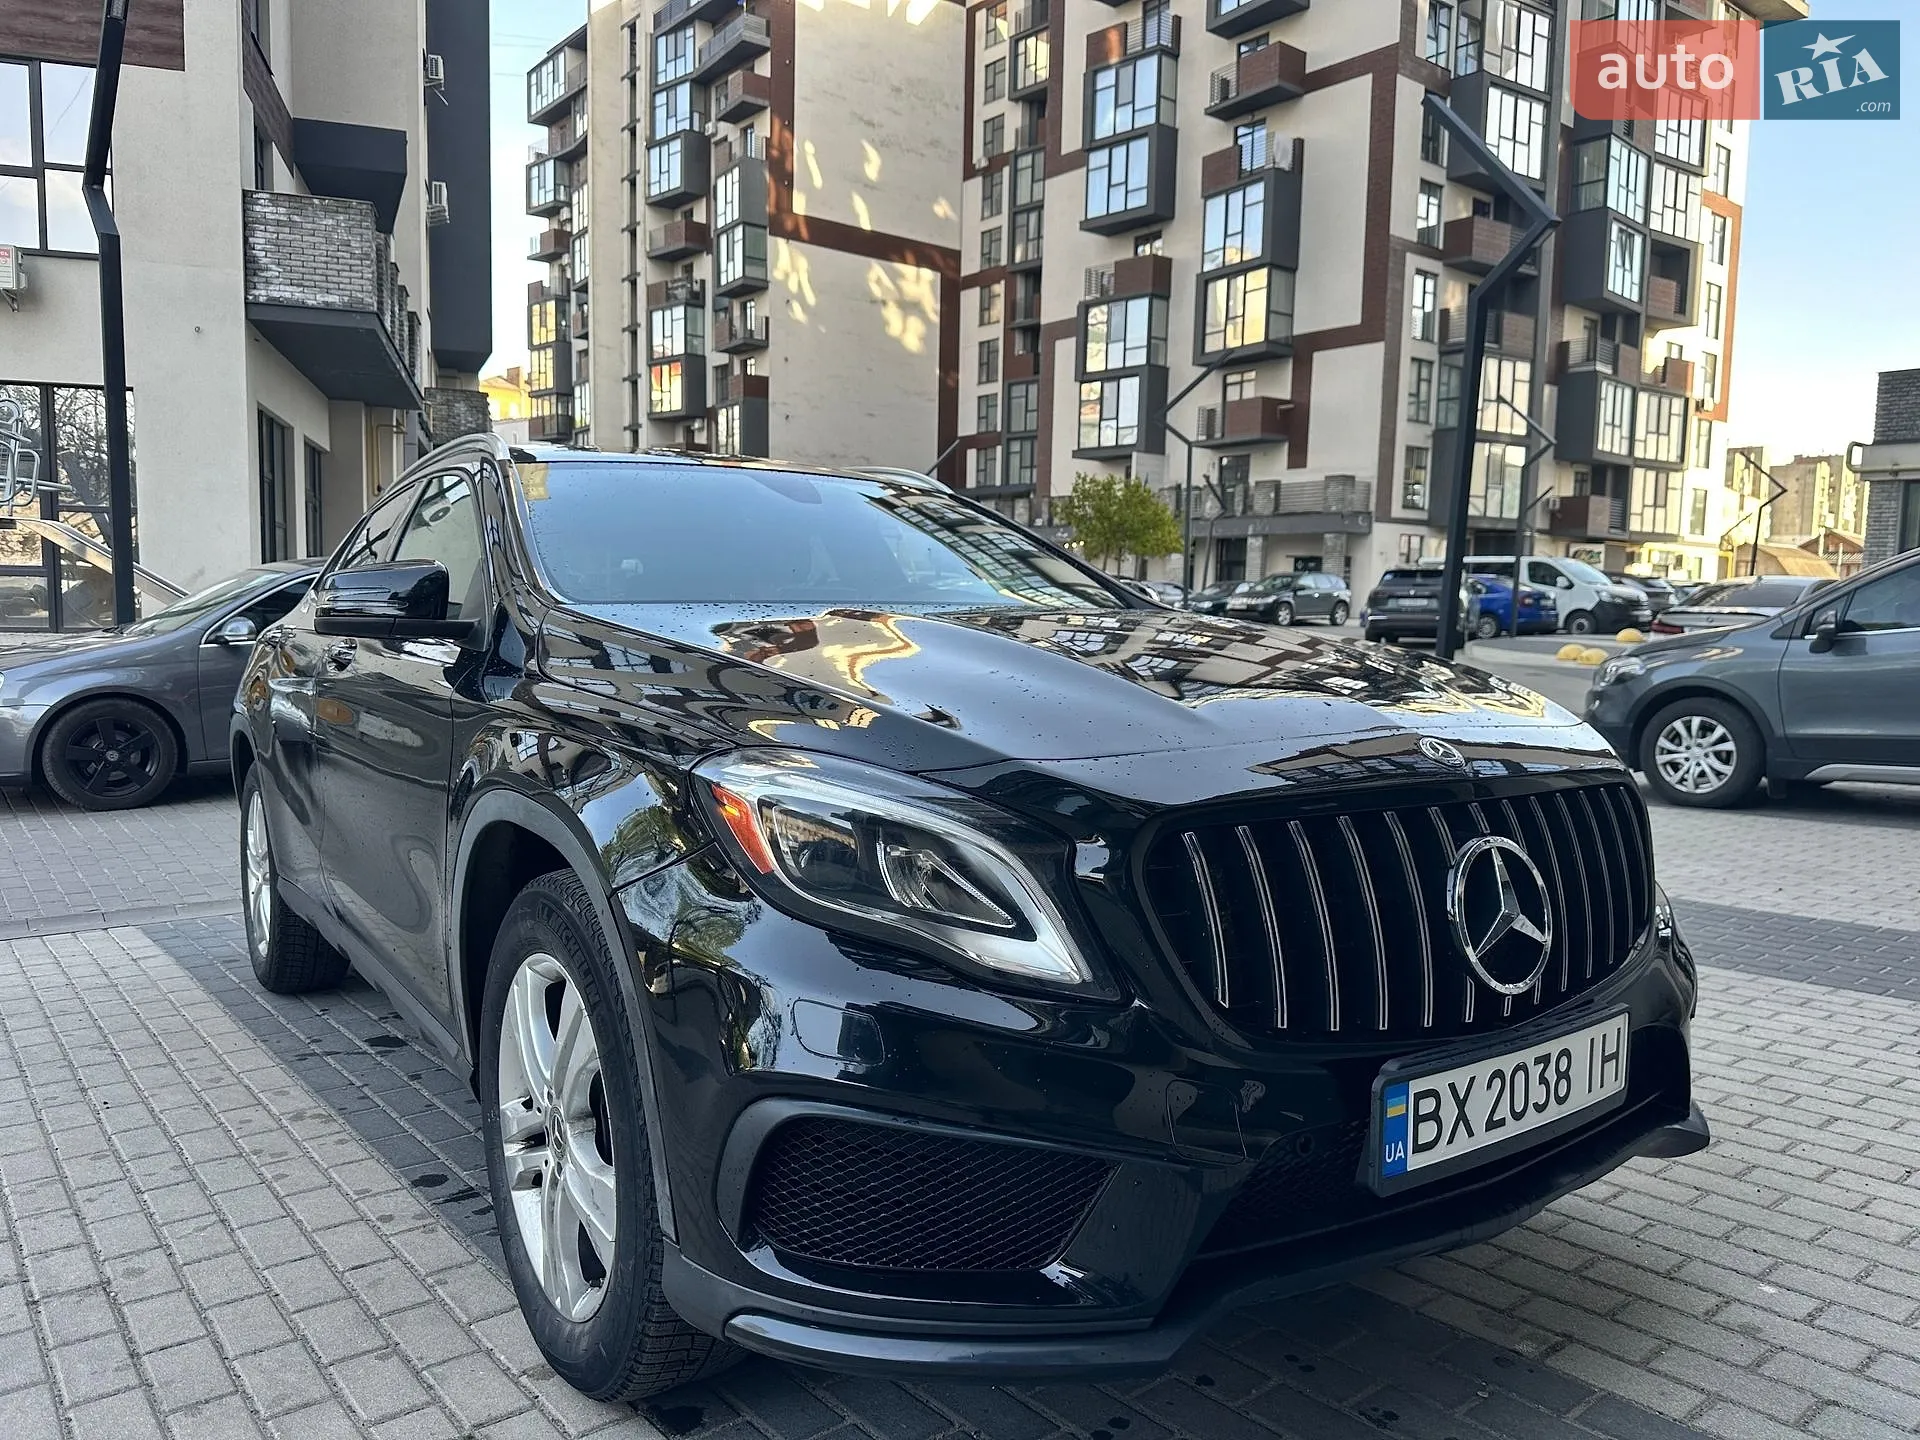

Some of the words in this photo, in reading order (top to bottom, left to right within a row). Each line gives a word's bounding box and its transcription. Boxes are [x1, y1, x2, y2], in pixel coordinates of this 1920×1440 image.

[548, 912, 602, 1007] MICHELIN
[1411, 1075, 1477, 1155] BX
[1484, 1047, 1572, 1133] 2038
[1587, 1027, 1622, 1094] IH
[1385, 1141, 1405, 1163] UA
